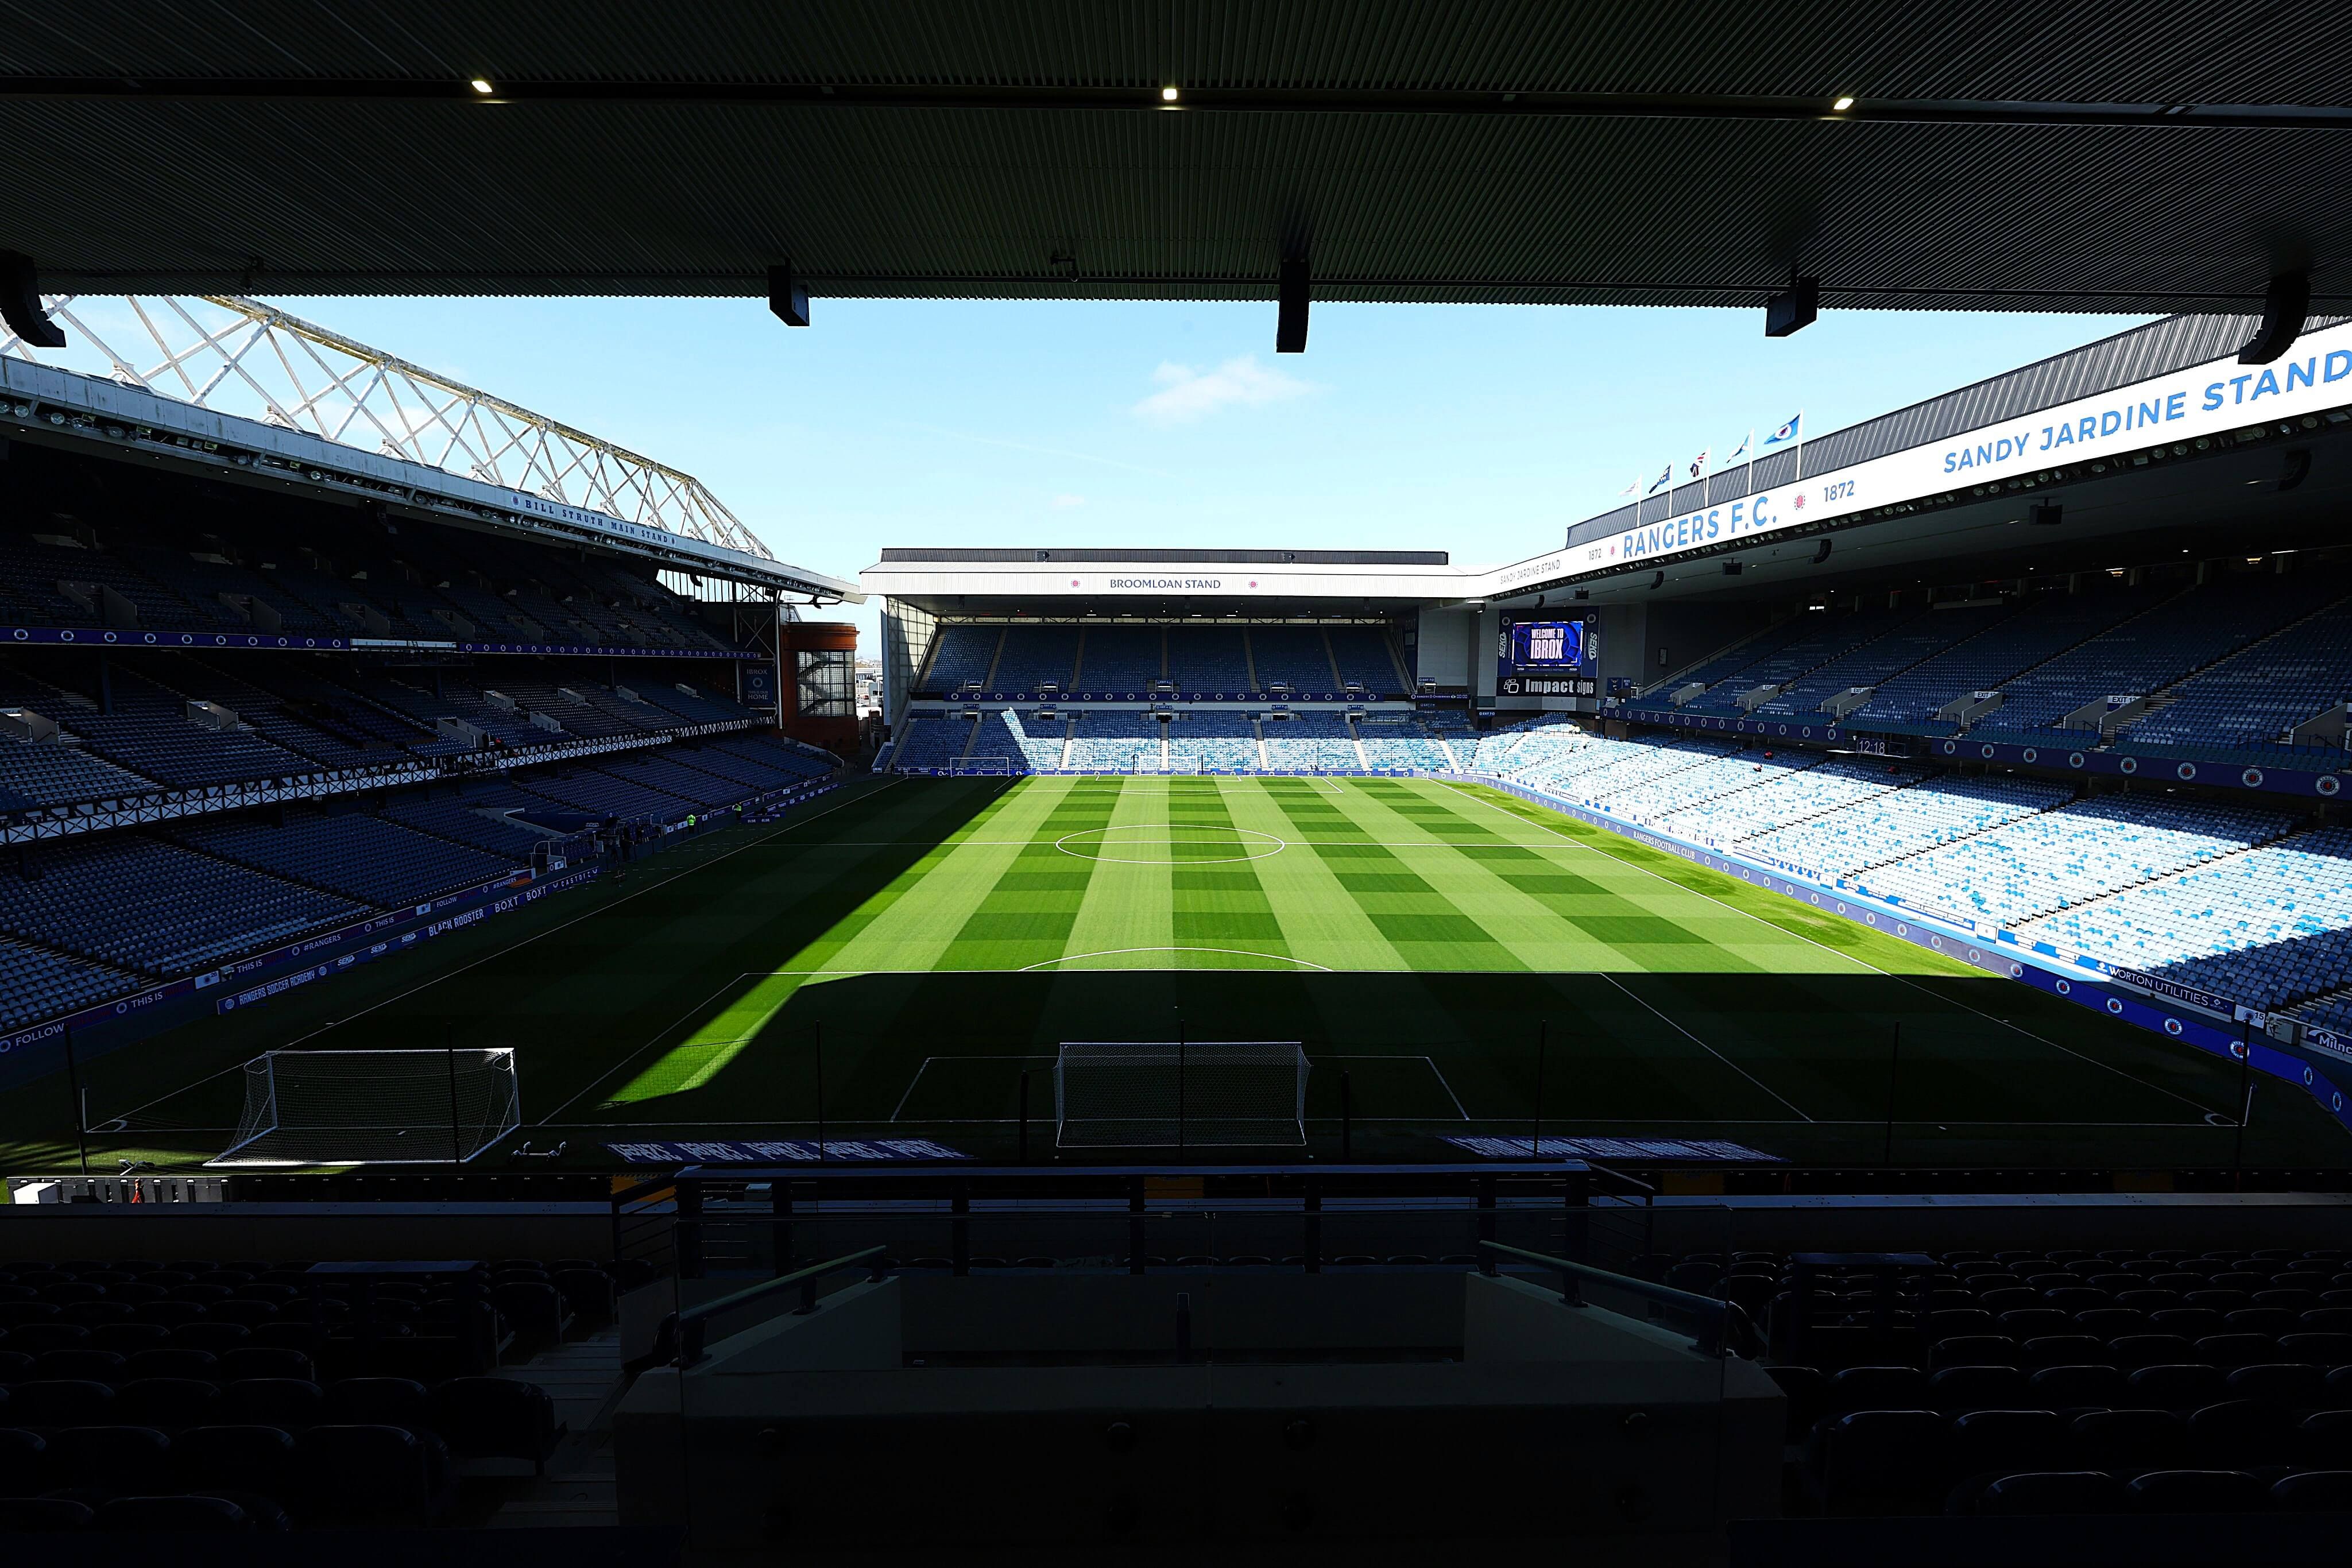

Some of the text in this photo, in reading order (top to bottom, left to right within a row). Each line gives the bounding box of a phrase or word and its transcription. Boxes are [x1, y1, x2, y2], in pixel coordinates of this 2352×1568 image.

[1944, 349, 2352, 474] SANDY JARDINE STAND
[1824, 480, 1854, 502] 1872
[525, 500, 667, 543] BILL STRUTH MAIN STAND
[1624, 496, 1777, 558] RANGERS F.C.
[1588, 548, 1602, 561] 1872
[1500, 559, 1560, 584] SANDY JARDINE STAND
[1110, 579, 1221, 589] BROOMLOAN STAND
[1531, 628, 1564, 639] WELCOME TO
[1499, 632, 1507, 659] SEKO
[1530, 639, 1564, 659] IBROX
[1588, 632, 1597, 660] SEKO
[1525, 679, 1593, 695] Impact signs
[1859, 740, 1886, 754] 12:18
[1633, 831, 1654, 845] RANGERS
[1654, 838, 1680, 855] FOOTBALL
[1681, 848, 1695, 860] CLUB
[493, 877, 517, 889] #RANGERS
[526, 886, 547, 901] BOXT
[436, 896, 457, 908] FOLLOW
[494, 896, 519, 913] BOXT
[375, 916, 394, 928] THIS IS
[428, 908, 484, 937] BLACK ROOSTER
[303, 934, 341, 951] #RANGERS
[401, 932, 417, 943] SEKO
[370, 943, 388, 954] SEKO
[237, 959, 262, 974] THIS IS
[337, 955, 355, 966] SEKO
[239, 969, 315, 1005] RANGERS SOCCER ACADEMY
[2109, 965, 2208, 1006] WORTON UTILITIES
[130, 992, 163, 1008] THIS IS
[2254, 1012, 2264, 1020] 15
[15, 1023, 65, 1047] FOLLOW
